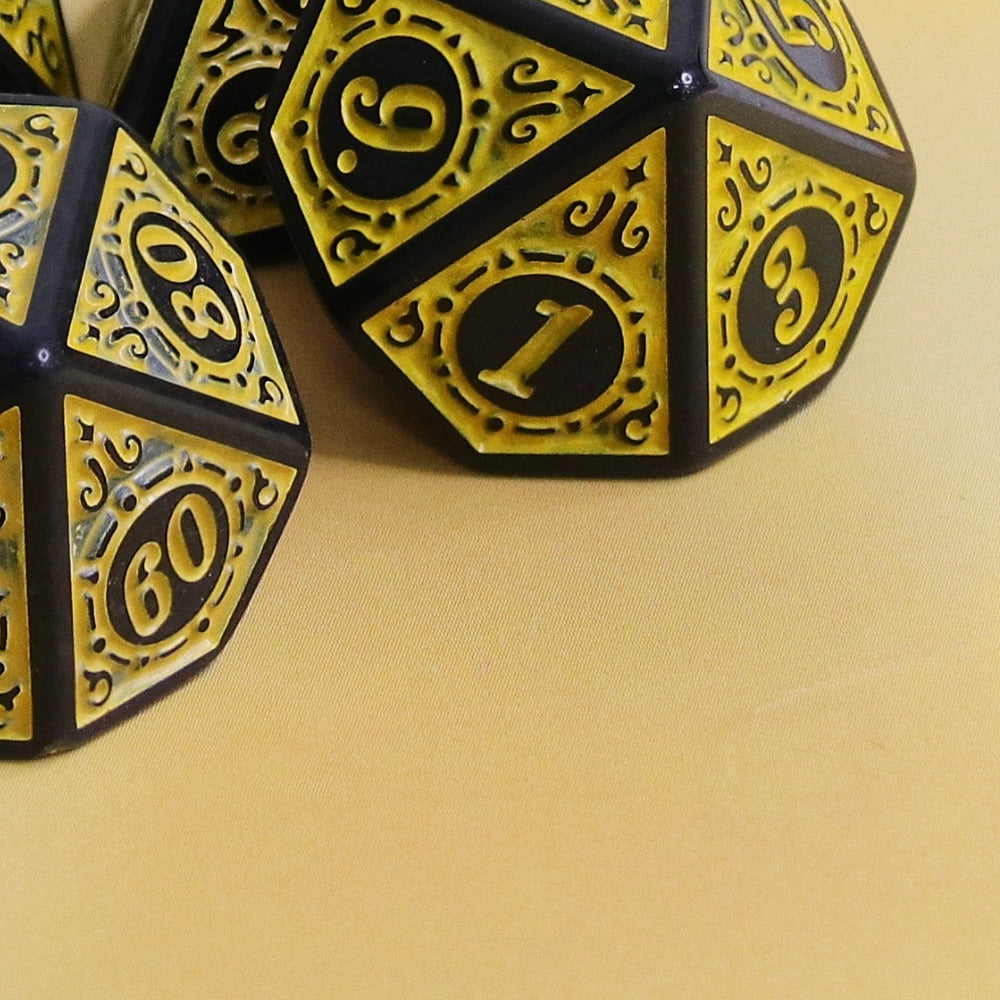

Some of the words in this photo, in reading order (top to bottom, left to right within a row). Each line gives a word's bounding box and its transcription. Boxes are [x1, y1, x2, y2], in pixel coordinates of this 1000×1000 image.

[135, 225, 234, 340] 80
[761, 225, 821, 347] 3
[478, 300, 594, 398] 1
[123, 493, 216, 637] 60
